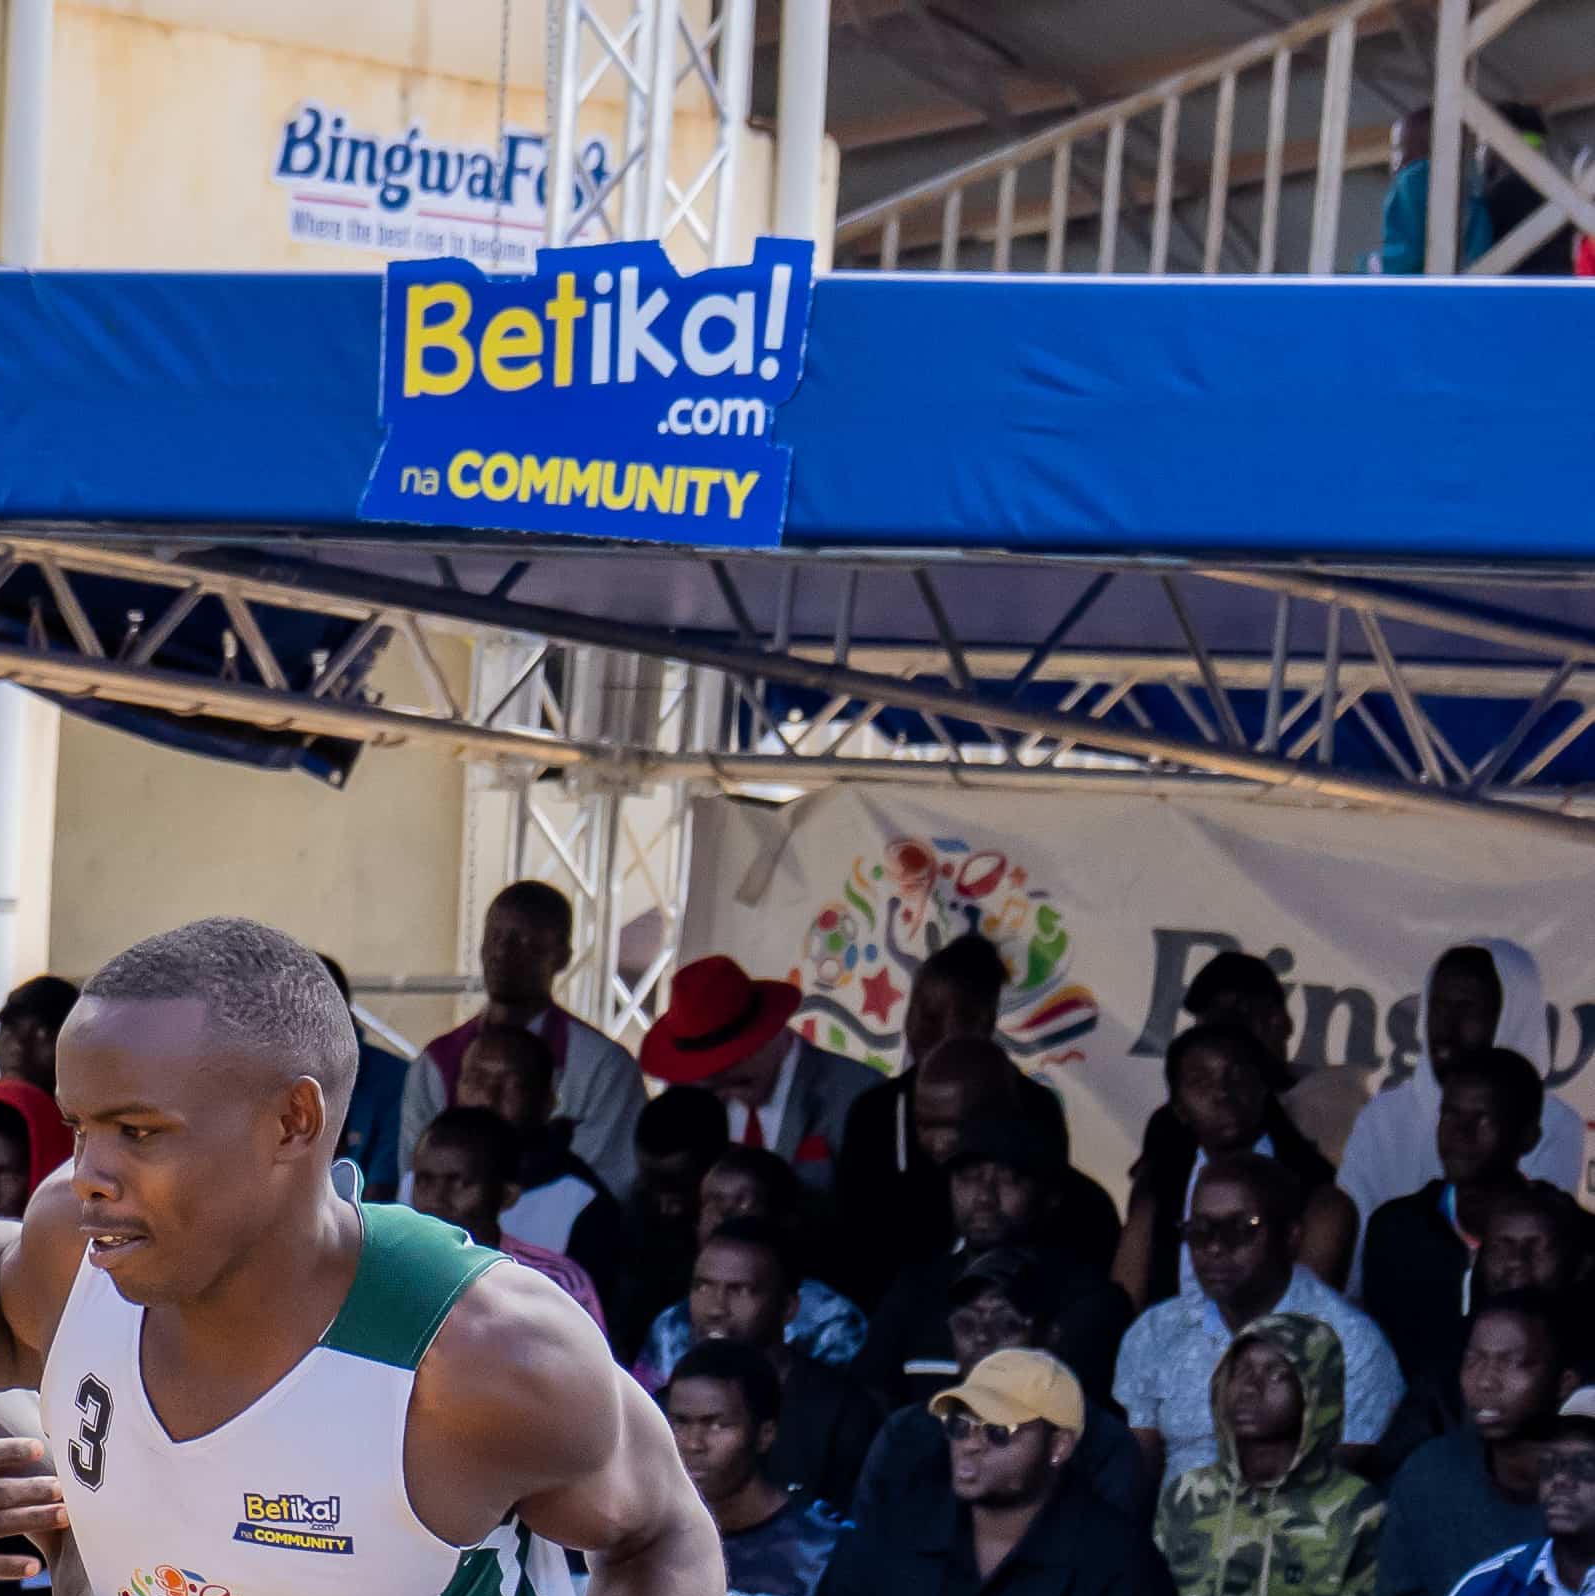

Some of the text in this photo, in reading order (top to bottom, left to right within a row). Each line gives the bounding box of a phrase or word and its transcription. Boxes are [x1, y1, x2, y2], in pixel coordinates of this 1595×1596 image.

[403, 264, 793, 398] Betika!
[657, 397, 766, 437] .com
[400, 449, 760, 520] na COMMUNITY
[68, 1372, 114, 1492] 3
[246, 1495, 339, 1522] Betika!
[254, 1529, 347, 1551] COMMUNITY
